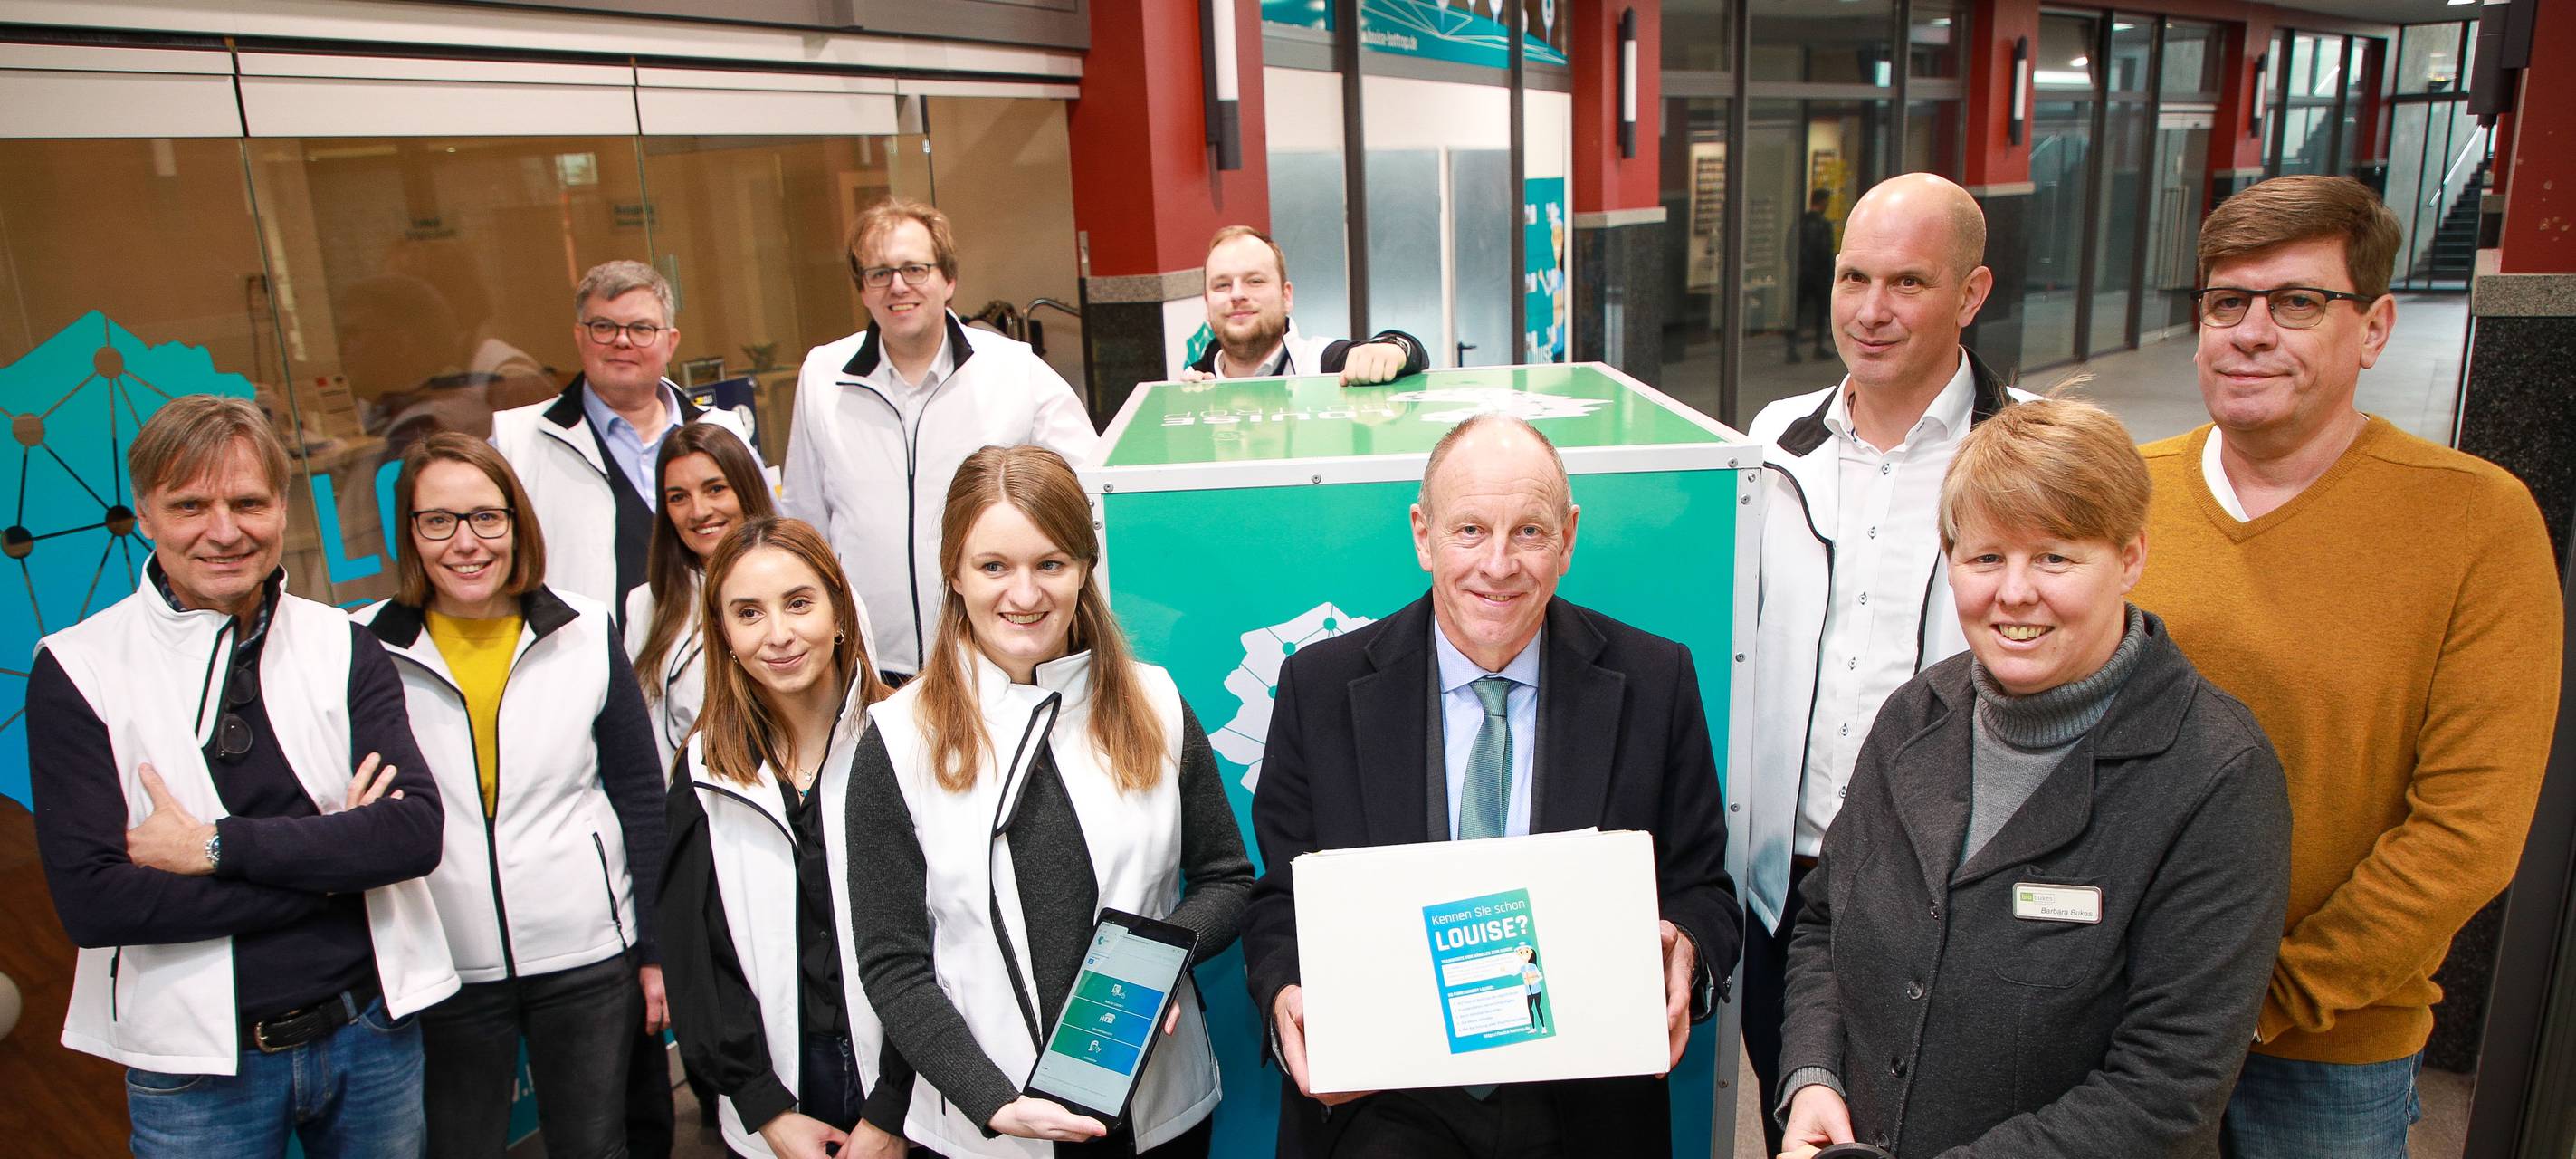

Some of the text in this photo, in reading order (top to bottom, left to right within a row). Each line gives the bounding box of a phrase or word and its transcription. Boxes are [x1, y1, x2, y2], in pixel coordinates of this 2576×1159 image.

[1161, 408, 1394, 426] LOUISE
[1431, 900, 1525, 925] Kennen Sie schon
[2041, 907, 2068, 915] Barbara
[1435, 915, 1528, 952] LOUISE?
